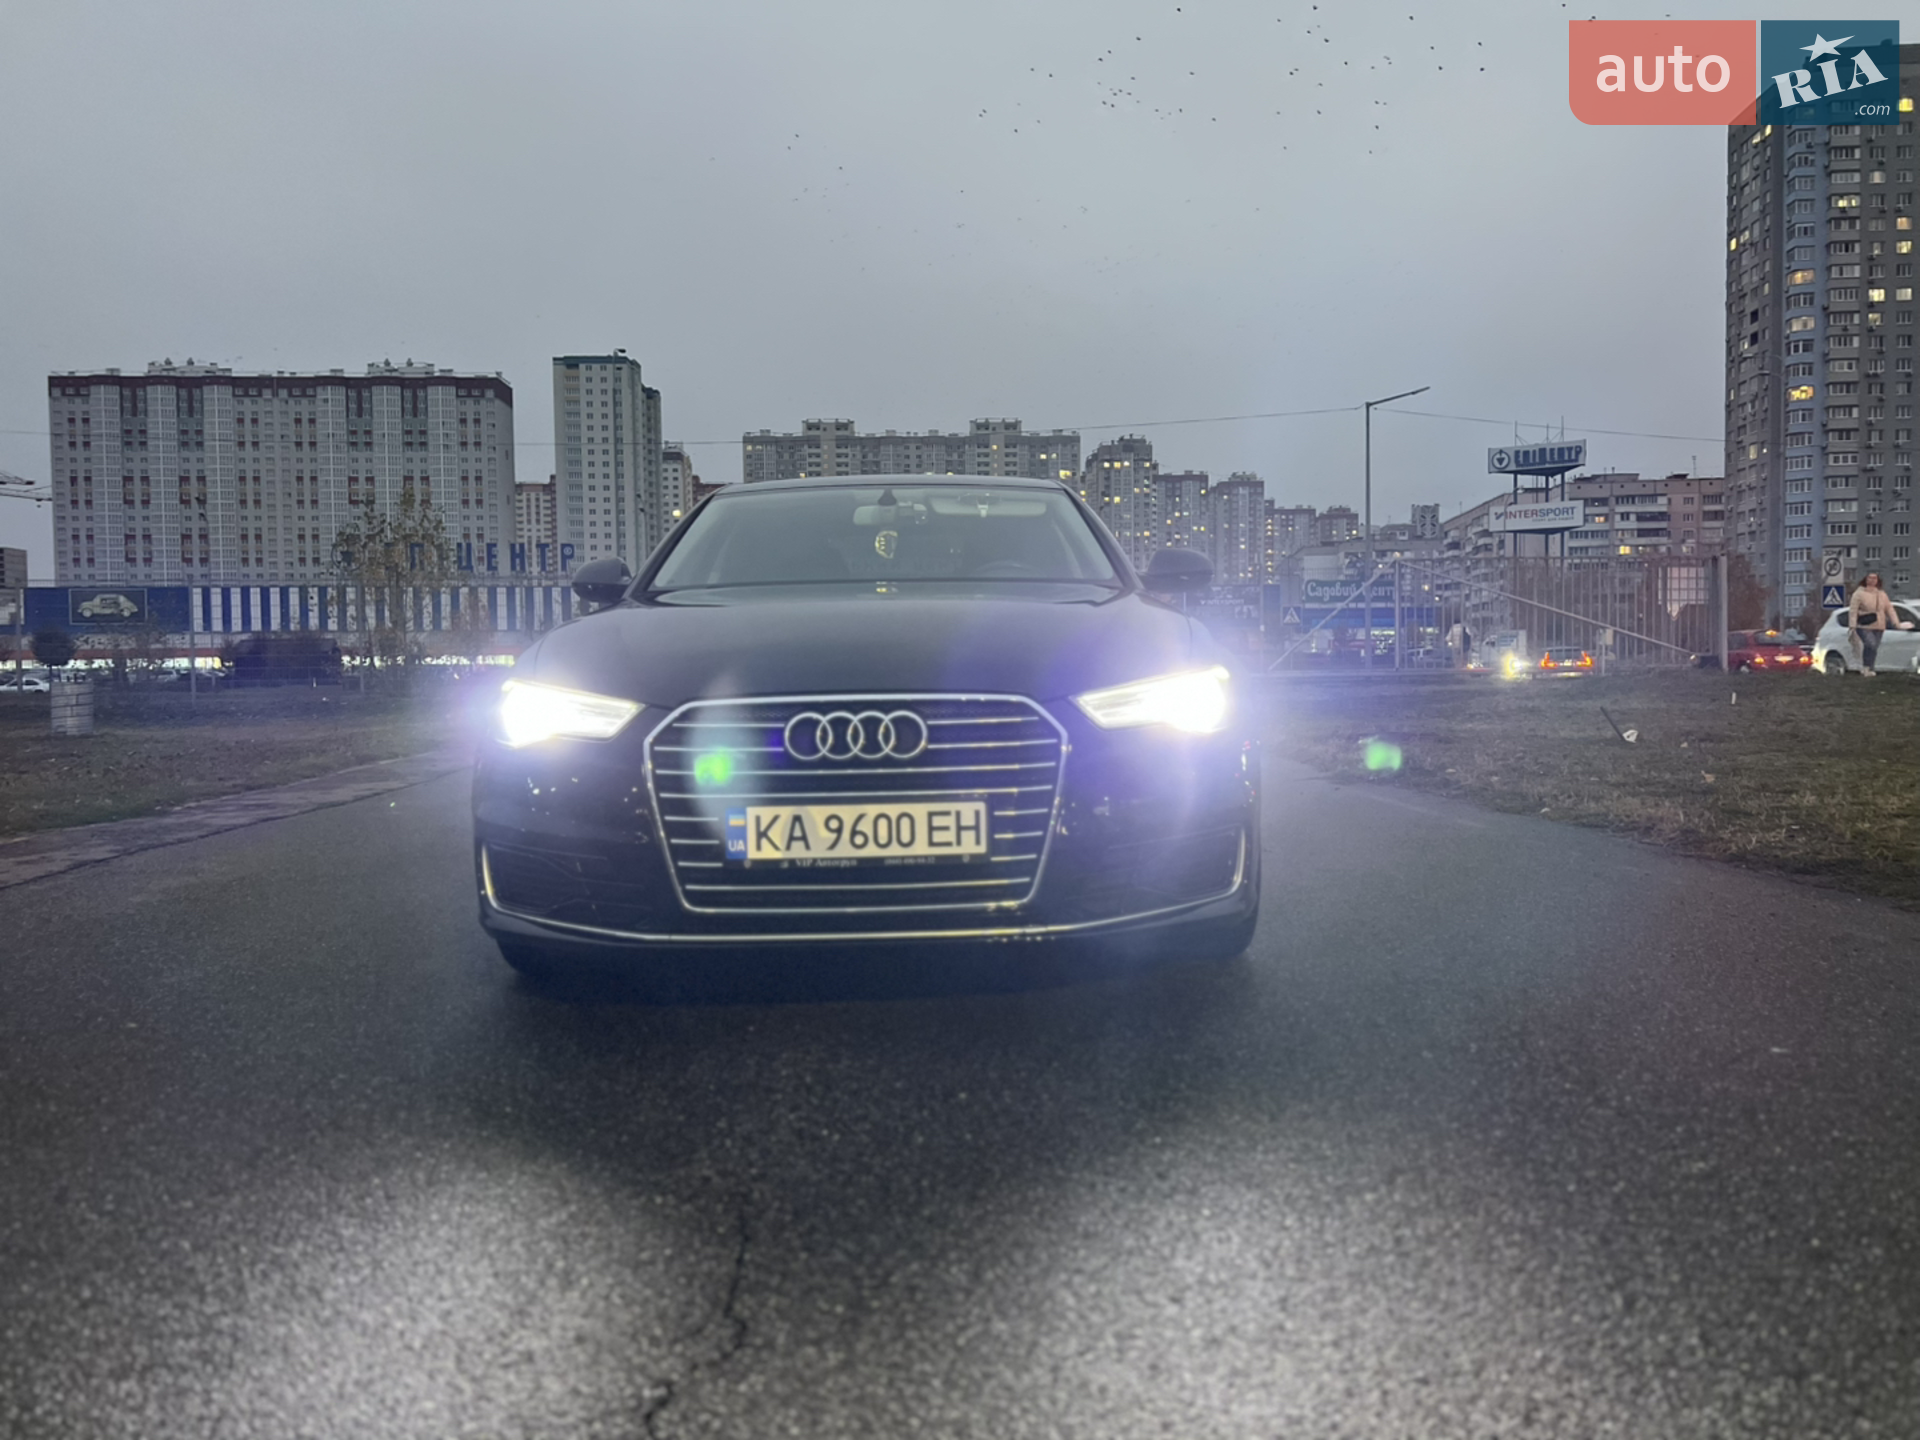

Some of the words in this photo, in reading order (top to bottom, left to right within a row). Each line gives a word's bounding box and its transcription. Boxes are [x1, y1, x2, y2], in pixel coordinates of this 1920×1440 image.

[1505, 506, 1577, 520] INTERSPORT
[755, 814, 811, 851] KA
[824, 812, 915, 850] 9600
[927, 809, 981, 847] EH
[728, 840, 745, 851] UA
